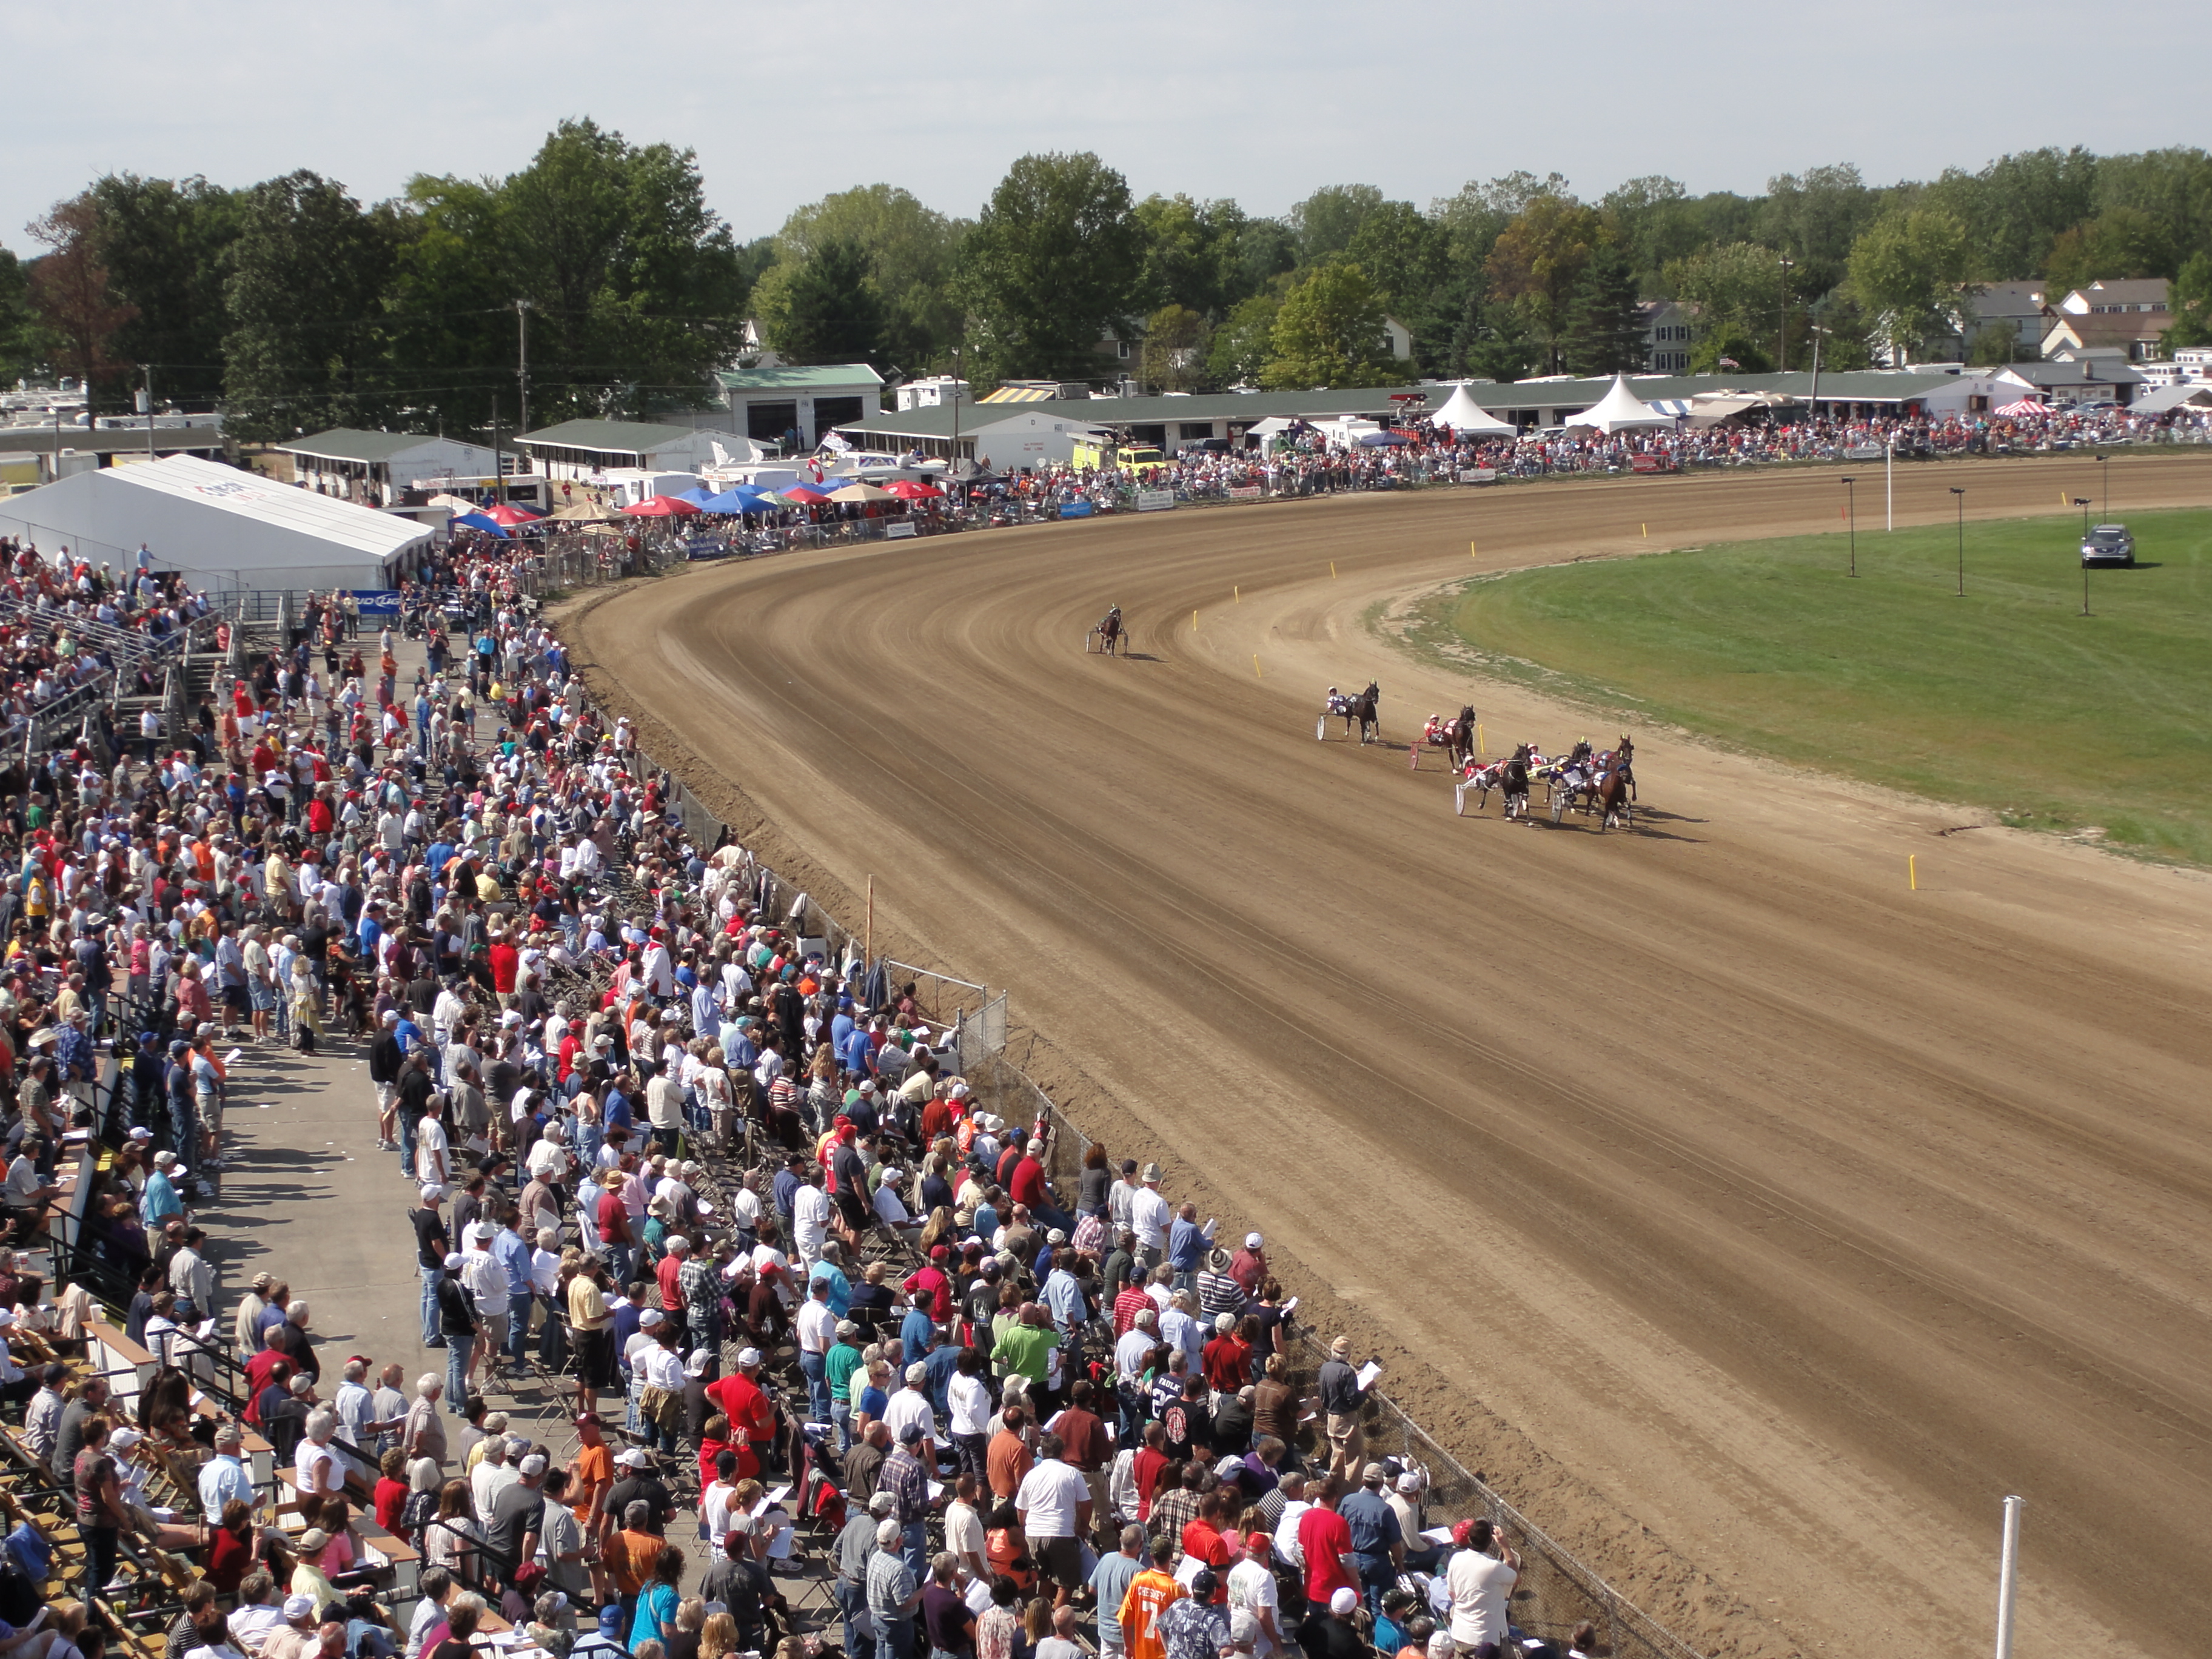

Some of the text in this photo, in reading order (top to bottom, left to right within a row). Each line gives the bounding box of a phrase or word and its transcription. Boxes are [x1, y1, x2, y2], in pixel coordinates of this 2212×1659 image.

[1158, 1377, 1181, 1392] FAULK
[1138, 1586, 1166, 1601] CHESNEY
[1142, 1600, 1158, 1639] 7
